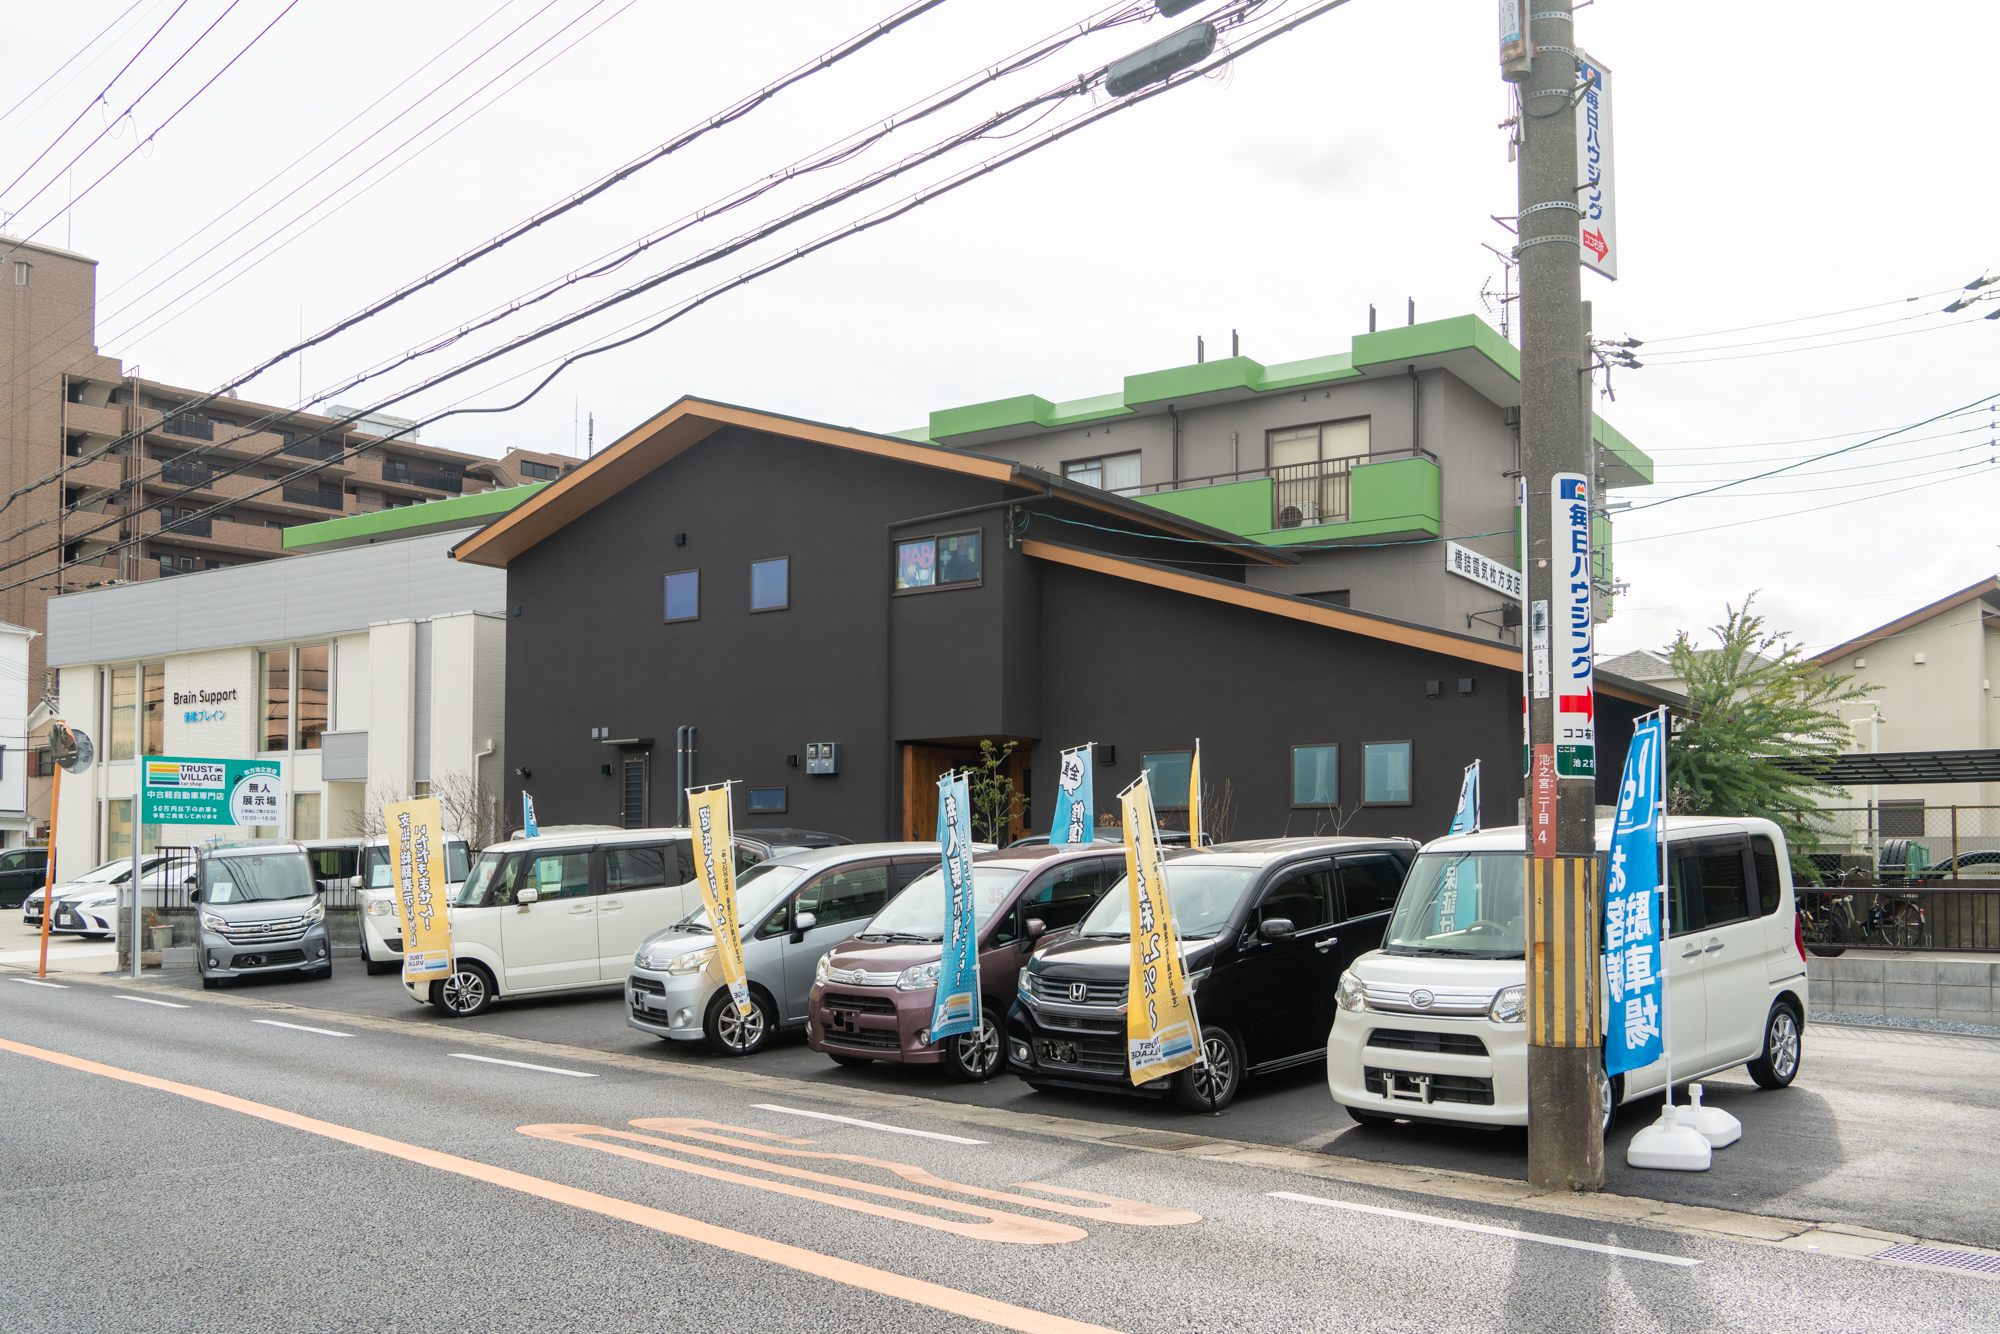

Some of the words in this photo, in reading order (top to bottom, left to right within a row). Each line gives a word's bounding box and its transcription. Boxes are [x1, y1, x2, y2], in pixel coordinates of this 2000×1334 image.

[1585, 90, 1602, 220] 毎日ハウジング
[1569, 504, 1591, 678] 毎日ハウジング
[173, 690, 197, 705] Brain
[199, 688, 237, 705] Support
[180, 764, 214, 773] TRUST
[180, 773, 223, 782] VILLAGE
[248, 783, 271, 793] 無人
[1538, 753, 1551, 825] 池之宮二丁目
[146, 790, 225, 800] 中古軽自動車専門店
[242, 796, 277, 806] 展示場
[1538, 829, 1548, 844] 4
